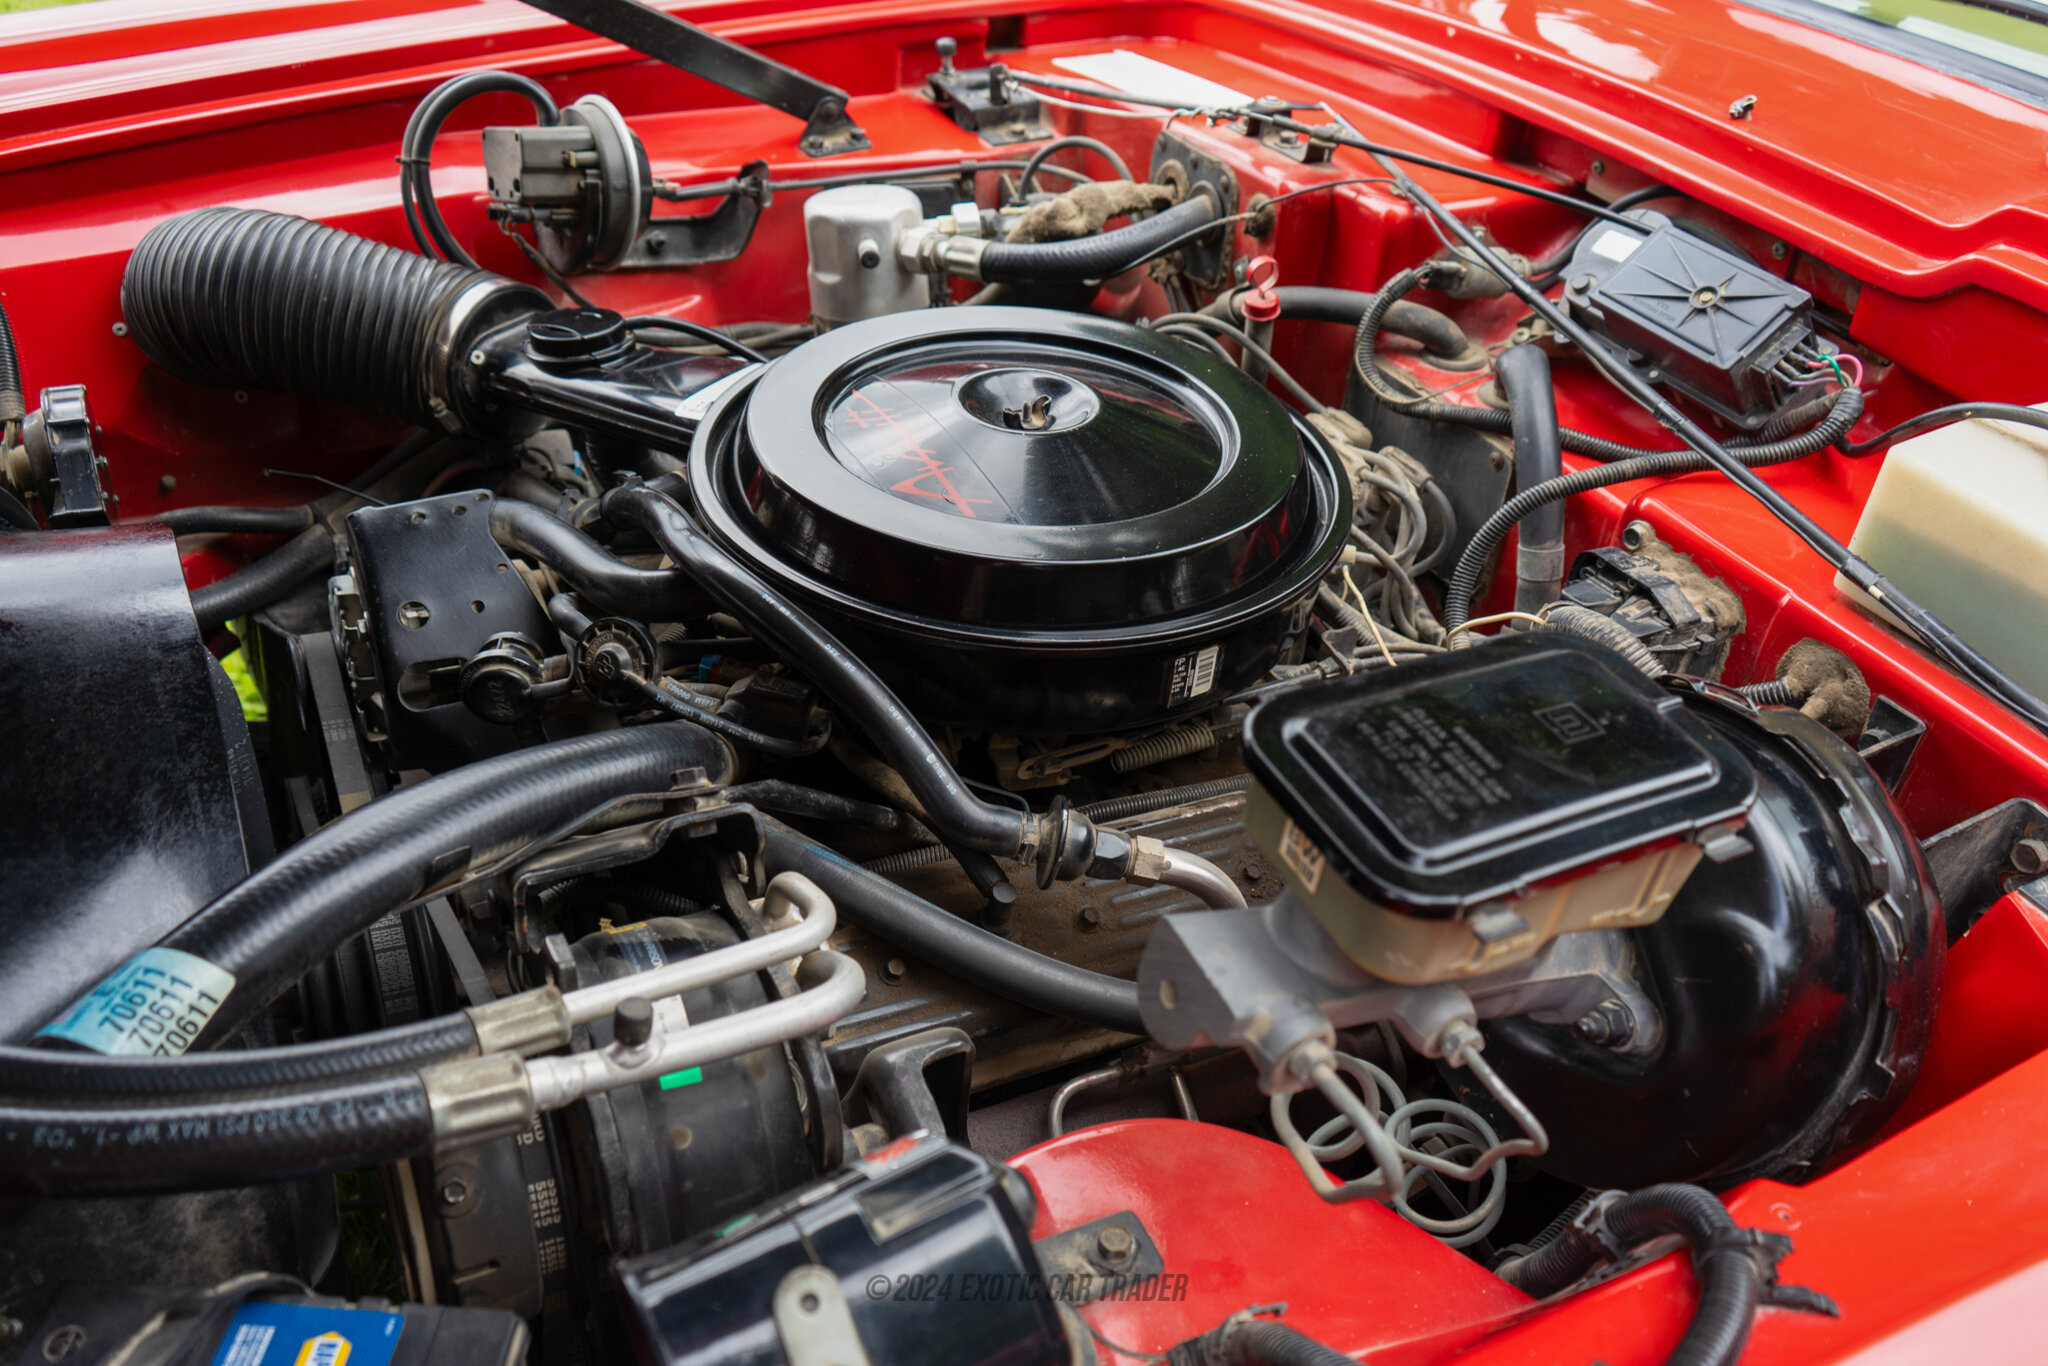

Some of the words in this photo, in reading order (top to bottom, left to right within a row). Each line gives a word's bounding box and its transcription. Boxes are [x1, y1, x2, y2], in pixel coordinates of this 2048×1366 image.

[99, 969, 166, 1034] 70611
[128, 976, 193, 1046] 70611
[156, 990, 219, 1057] 70611
[535, 1180, 552, 1227] 55515
